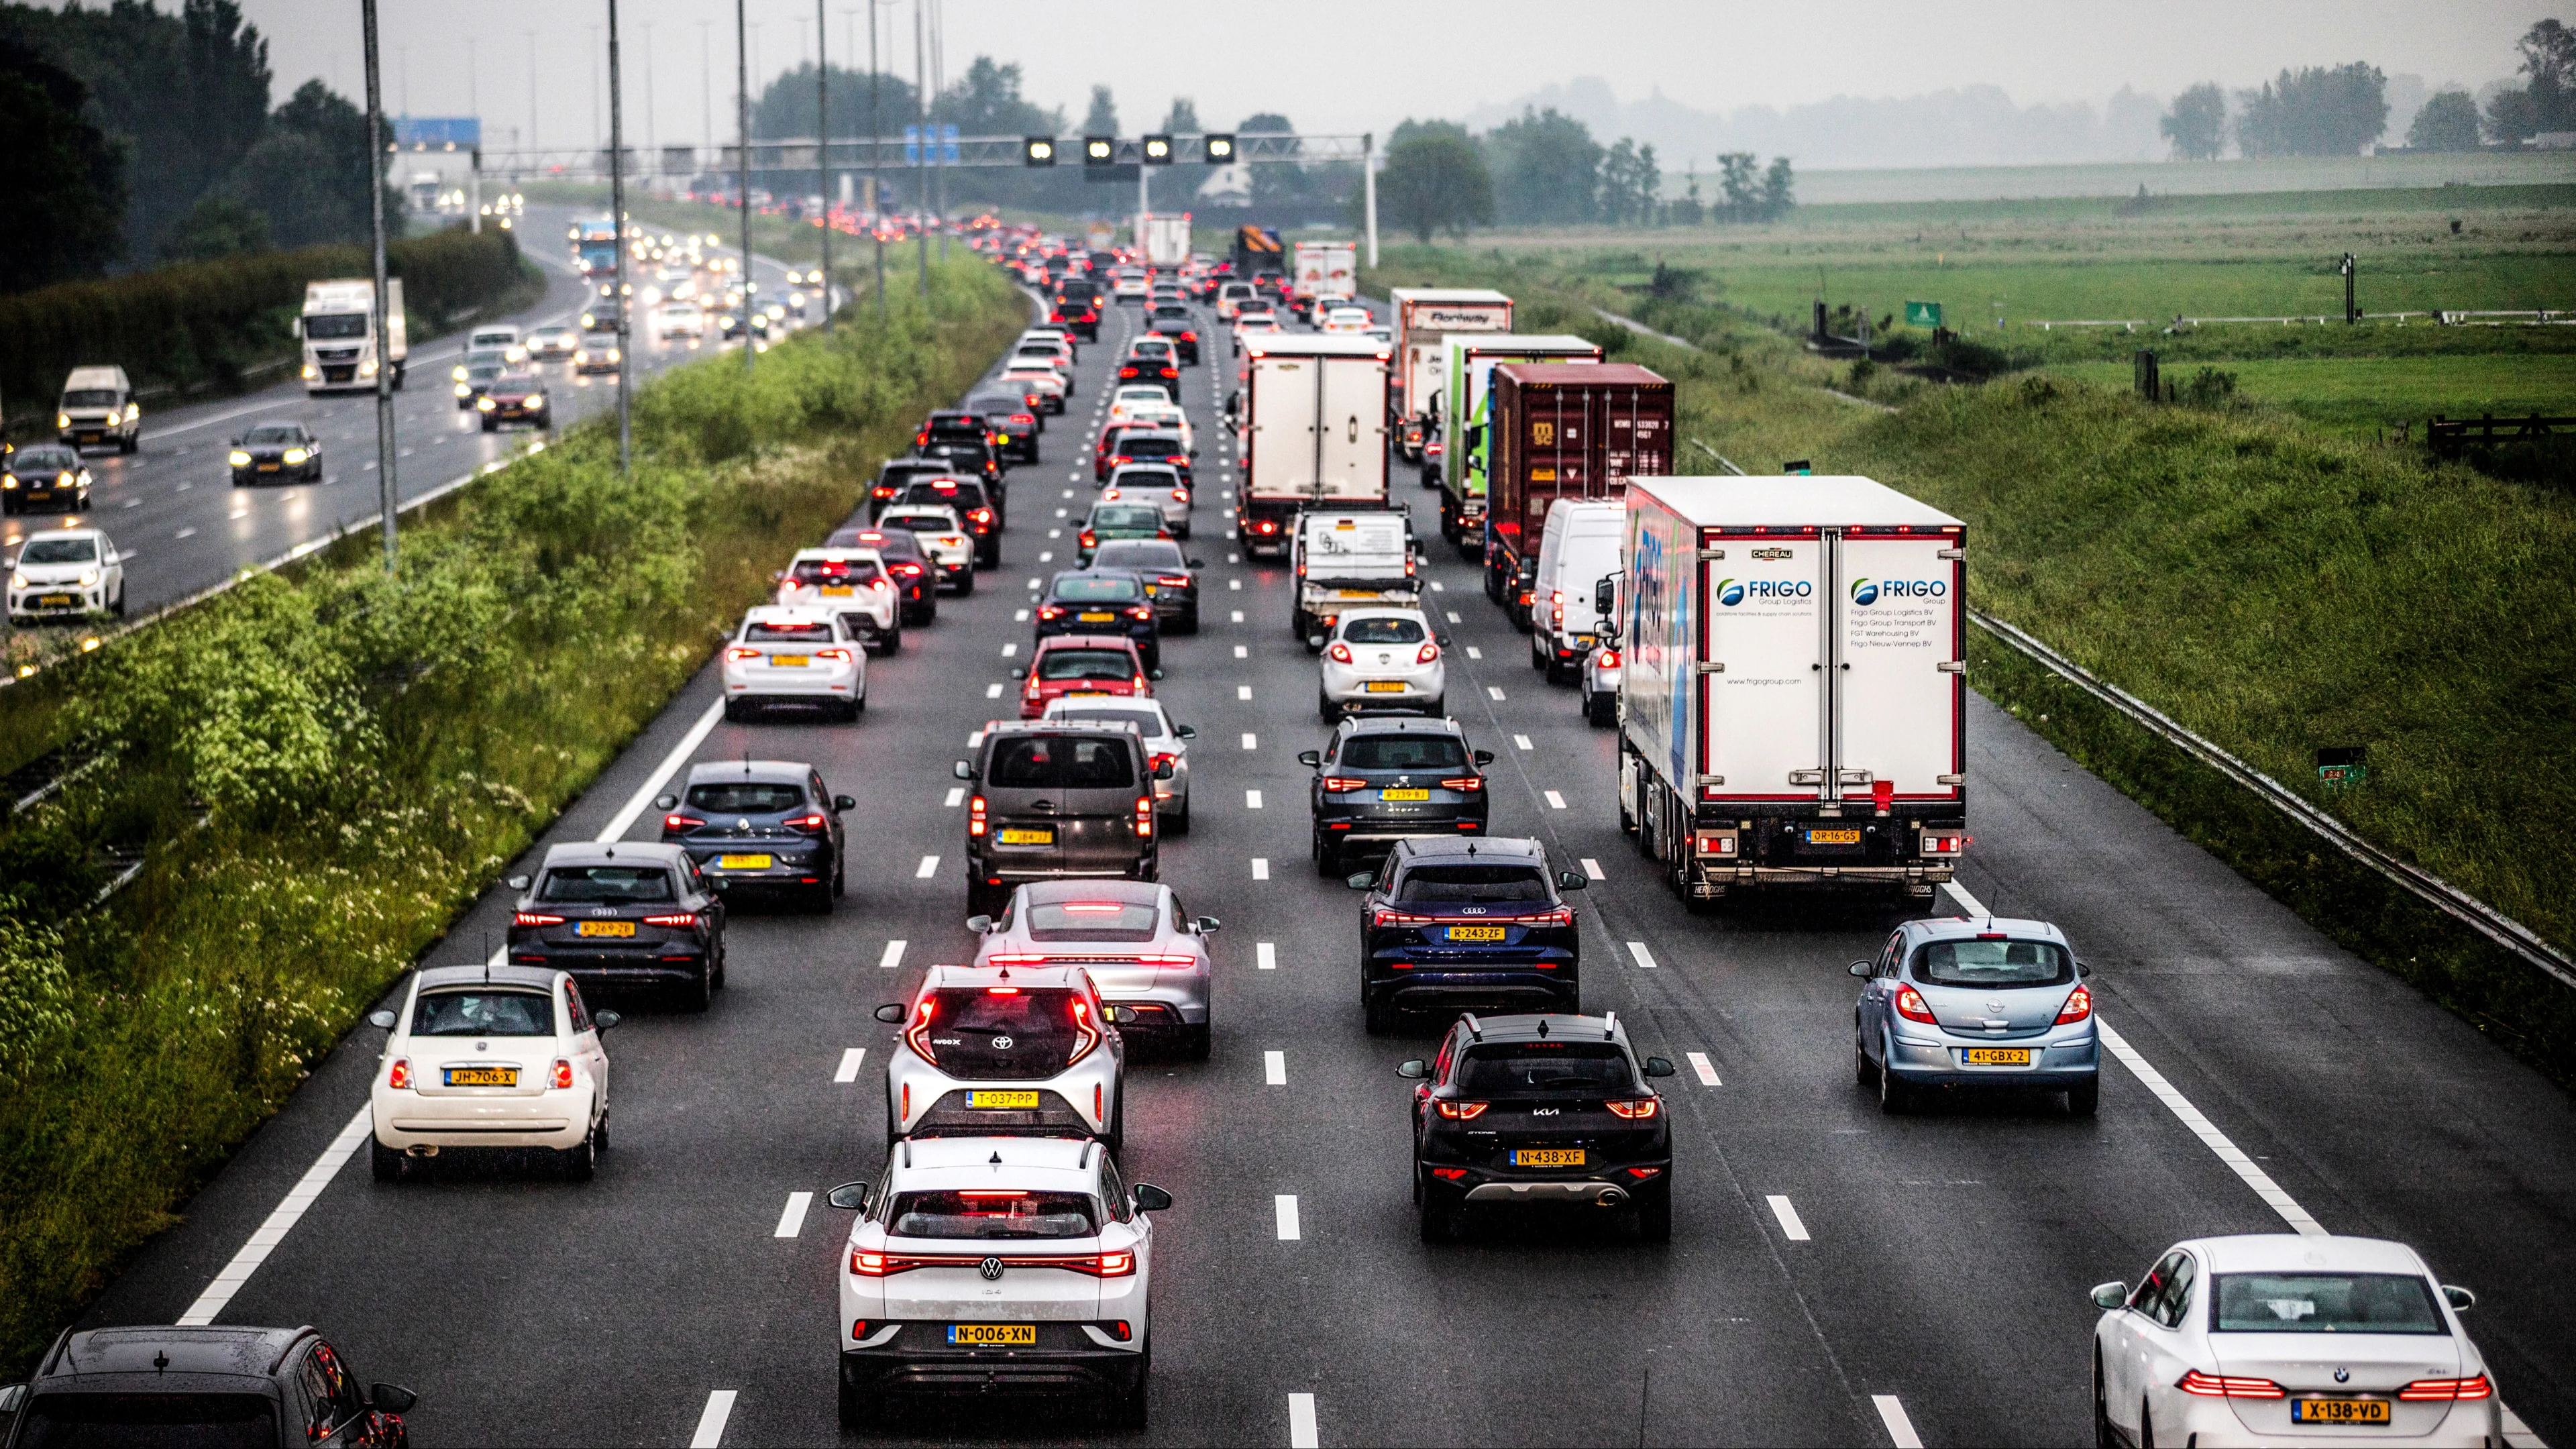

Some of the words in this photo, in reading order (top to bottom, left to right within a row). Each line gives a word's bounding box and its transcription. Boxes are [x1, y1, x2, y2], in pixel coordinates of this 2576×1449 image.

[1752, 550, 1791, 558] CHEREAU
[1750, 581, 1811, 597] FRIGO
[1883, 580, 1945, 596] FRIGO
[1815, 832, 1856, 840] OR-16-GS
[1454, 928, 1500, 938] R-243-ZF
[1974, 1051, 2024, 1061] 41-GBX-2
[456, 1072, 511, 1082] JH-706-X
[979, 1094, 1032, 1104] T-037-PP
[1521, 1152, 1580, 1163] N-438-XF
[959, 1328, 1031, 1341] N-006-XN
[2310, 1403, 2381, 1417] X-138-VD
